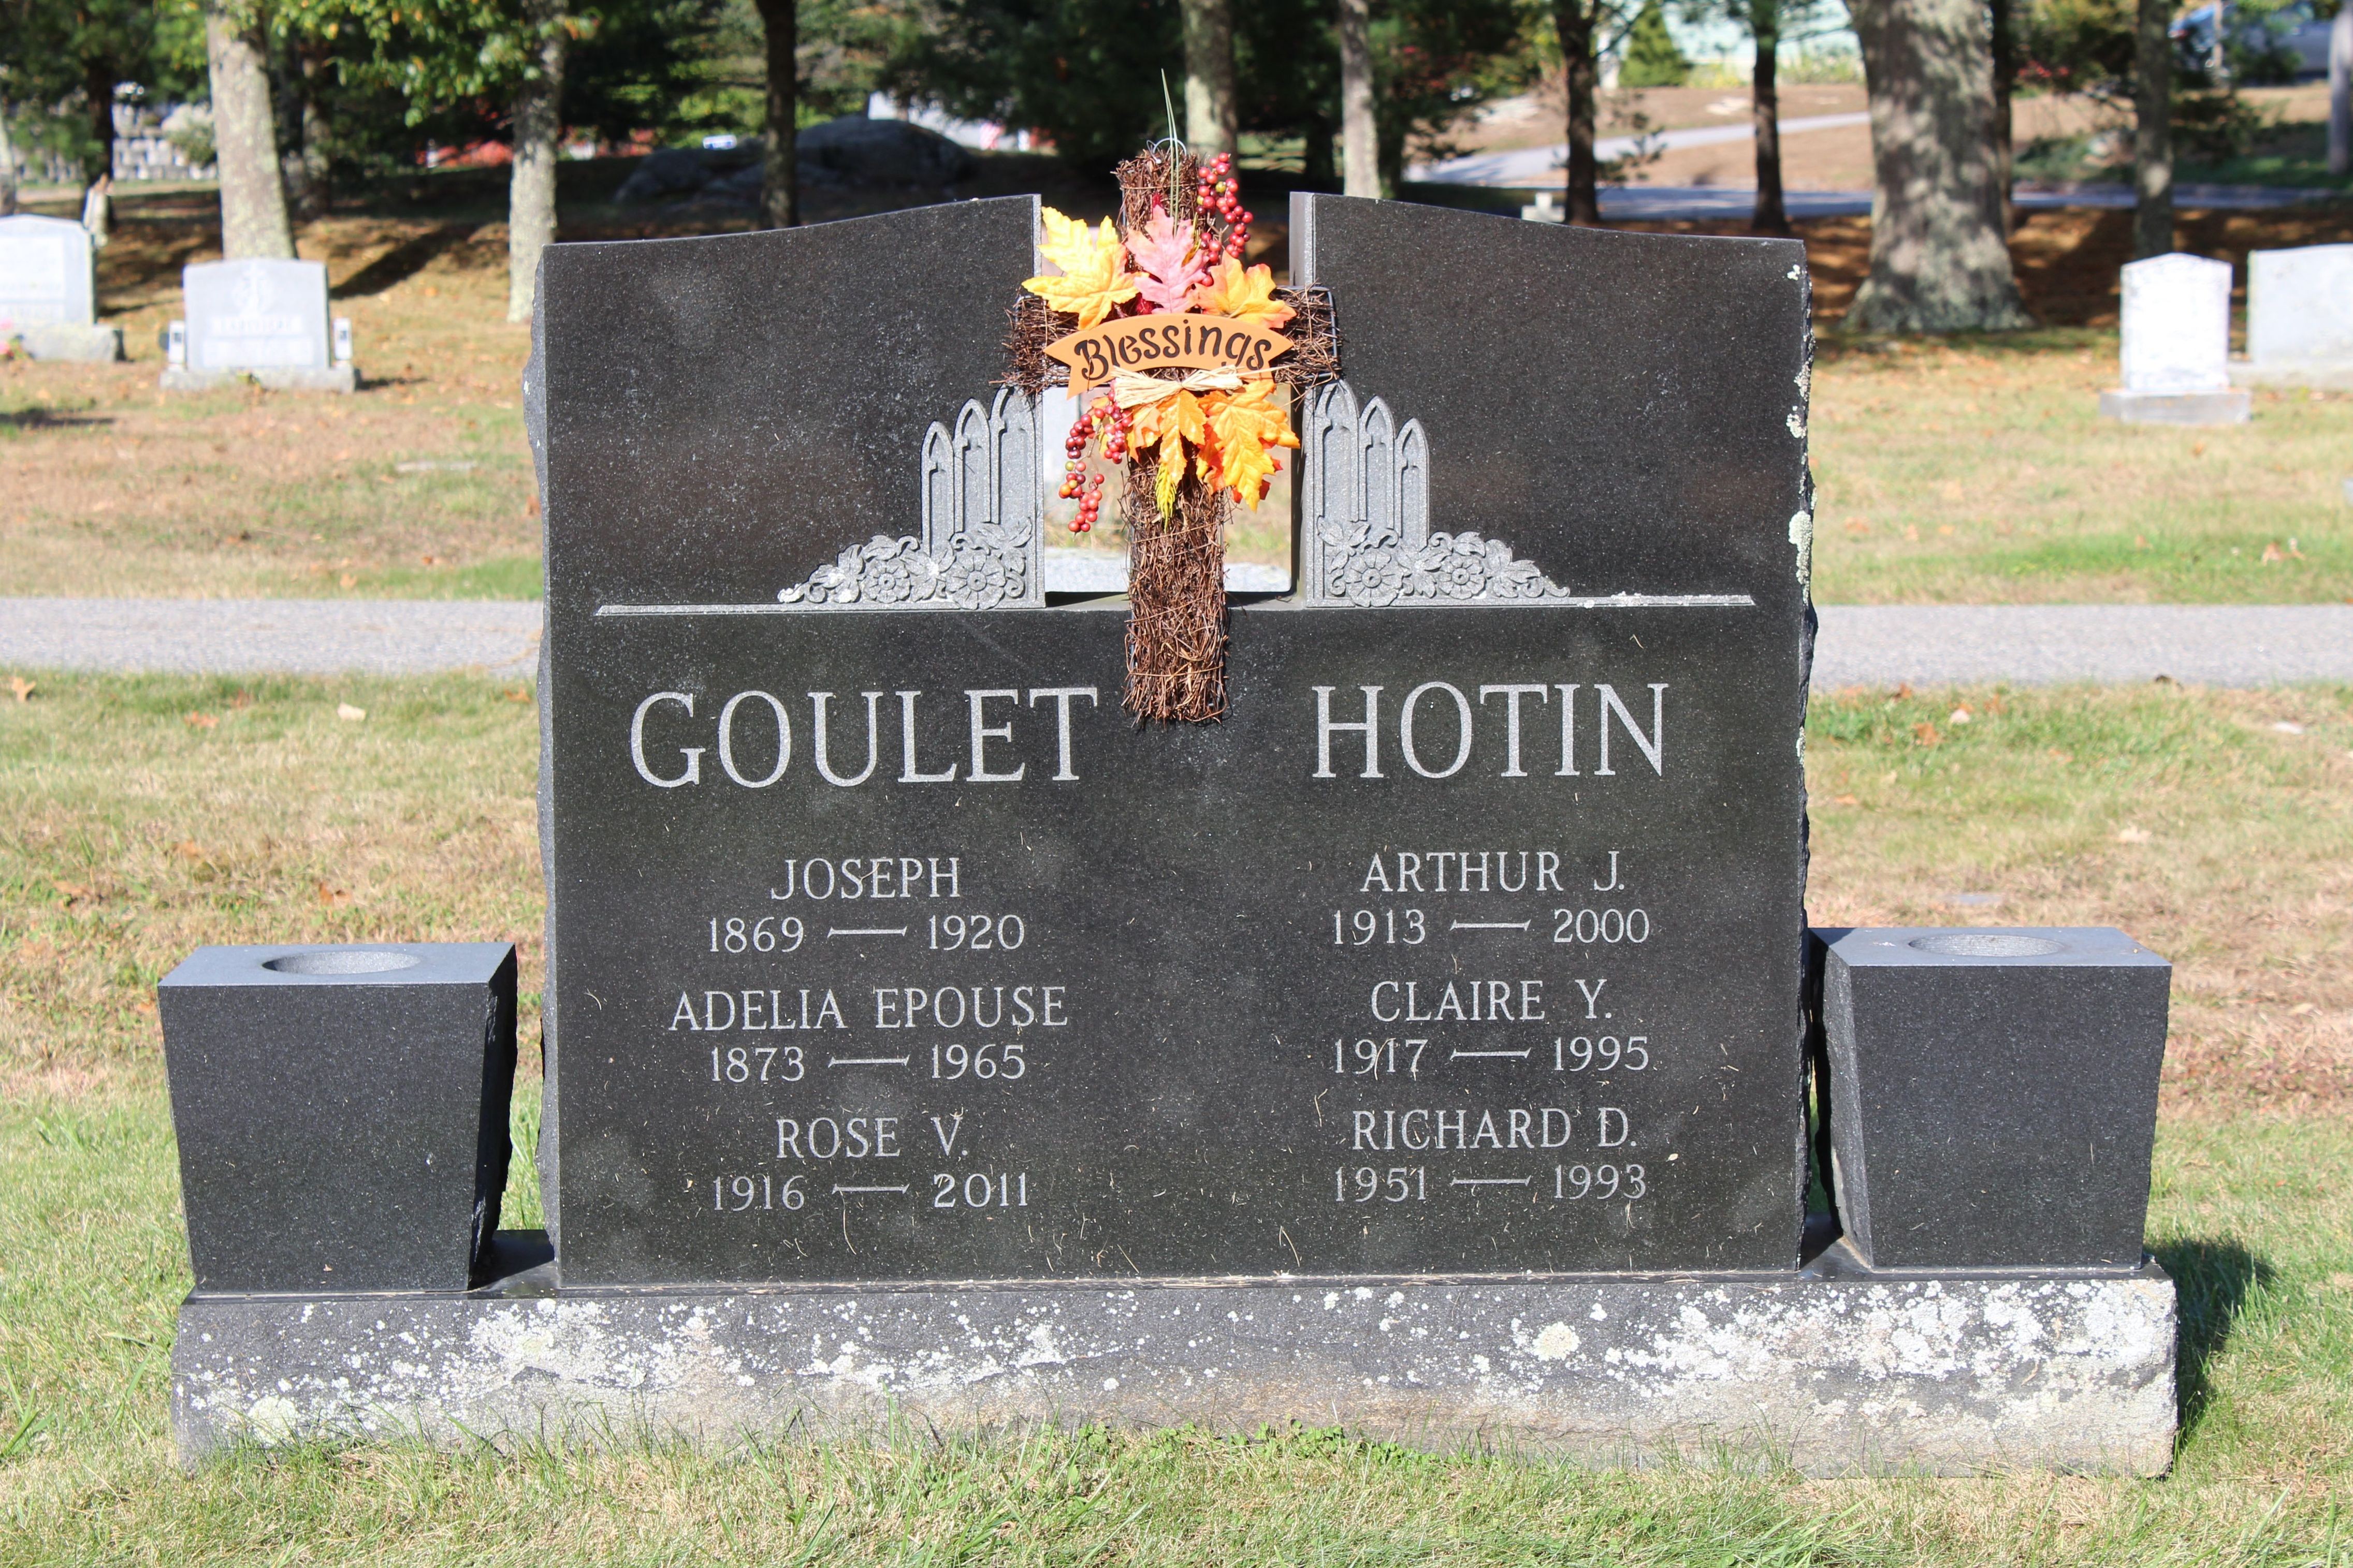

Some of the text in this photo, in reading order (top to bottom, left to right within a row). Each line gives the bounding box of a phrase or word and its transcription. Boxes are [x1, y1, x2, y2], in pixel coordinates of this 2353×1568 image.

[1073, 319, 1272, 381] Blessings
[630, 686, 1099, 789] GOULET
[1311, 680, 1670, 779] HOTIN
[769, 856, 962, 901] JOSEPH
[1359, 848, 1625, 893] ARTHUR J.
[709, 915, 805, 955] 1869
[928, 913, 1027, 952] 1920
[1333, 907, 1427, 946] 1913
[1553, 907, 1650, 944] 2000
[667, 985, 1069, 1032] ADELIA EPOUSE
[1370, 977, 1613, 1023] CLAIRE Y.
[710, 1045, 805, 1083] 1873
[931, 1043, 1026, 1080] 1965
[1334, 1037, 1429, 1074] 1917
[1553, 1035, 1650, 1072] 1995
[776, 1115, 969, 1159] ROSE V.
[1352, 1106, 1638, 1151] RICHARD D.
[712, 1174, 805, 1212] 1916
[933, 1172, 1028, 1209] 2011
[1334, 1165, 1427, 1203] 1951
[1553, 1163, 1647, 1200] 1993
